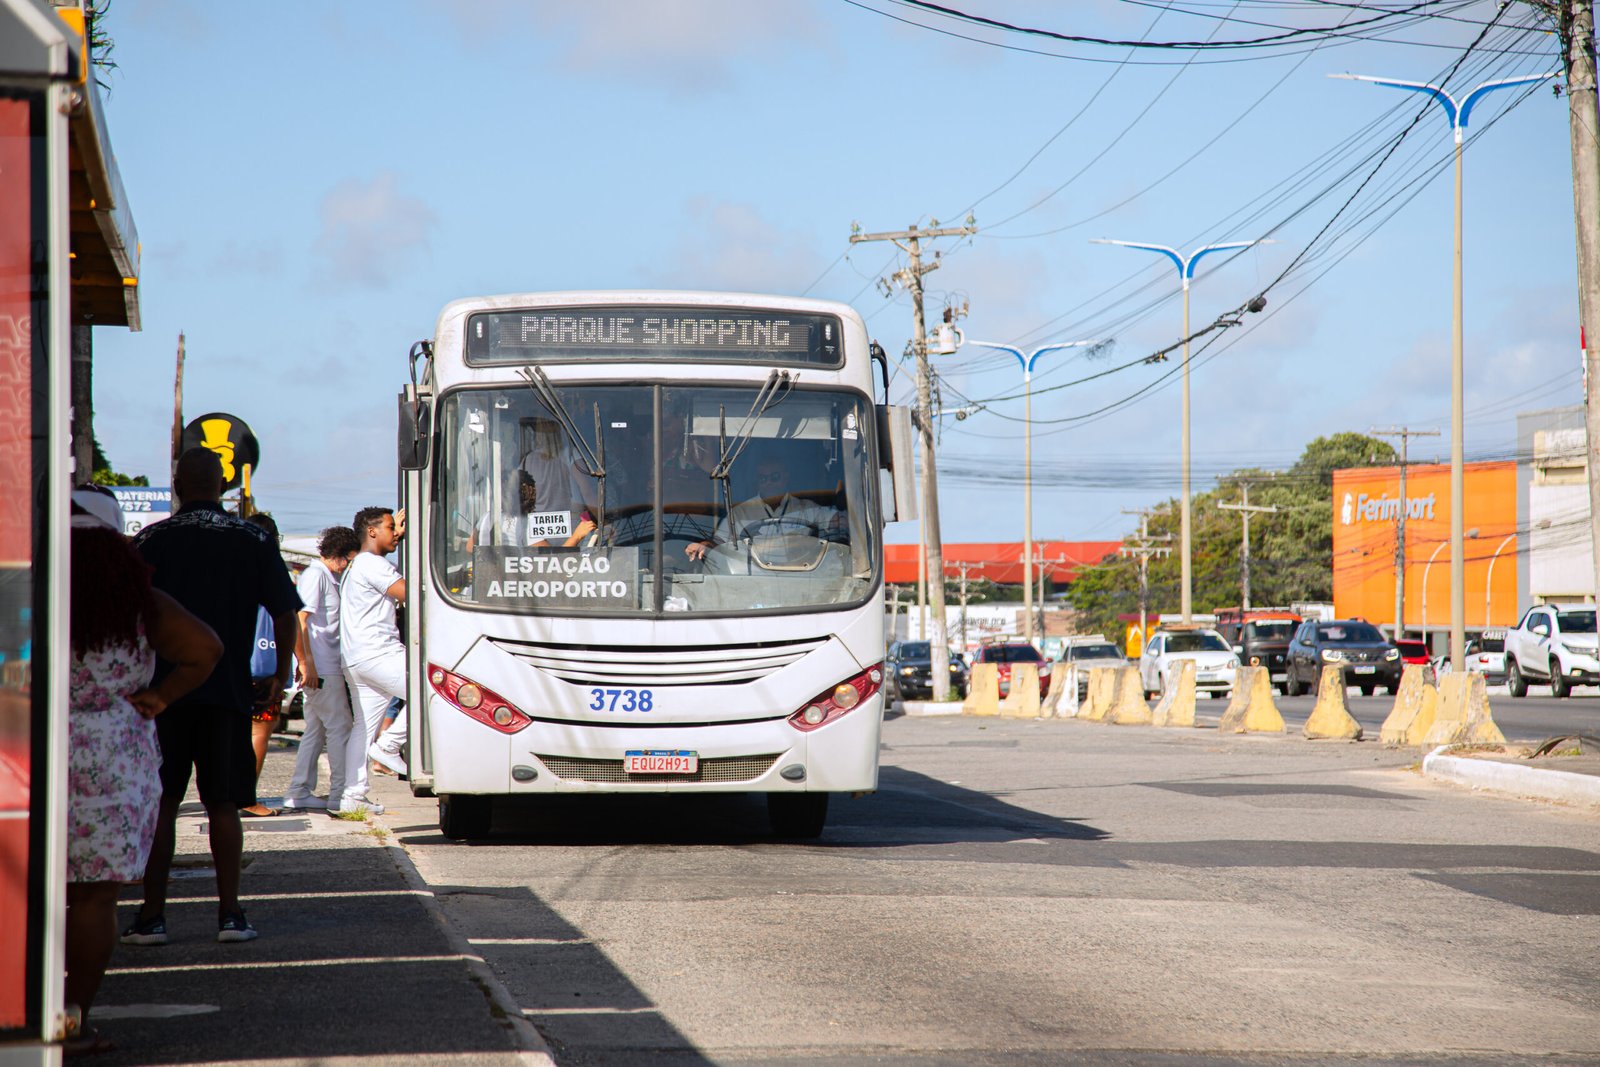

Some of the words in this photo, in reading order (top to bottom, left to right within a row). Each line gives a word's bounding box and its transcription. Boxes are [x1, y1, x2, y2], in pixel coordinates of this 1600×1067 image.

[521, 316, 634, 344] PARQUE
[642, 318, 790, 346] SHOPPING
[534, 514, 565, 525] TARIFA
[547, 525, 567, 536] 5,20
[504, 553, 611, 578] ESTAÇÃO
[486, 580, 628, 598] AEROPORTO
[589, 688, 653, 712] 3738
[631, 757, 690, 771] EQU2H91
